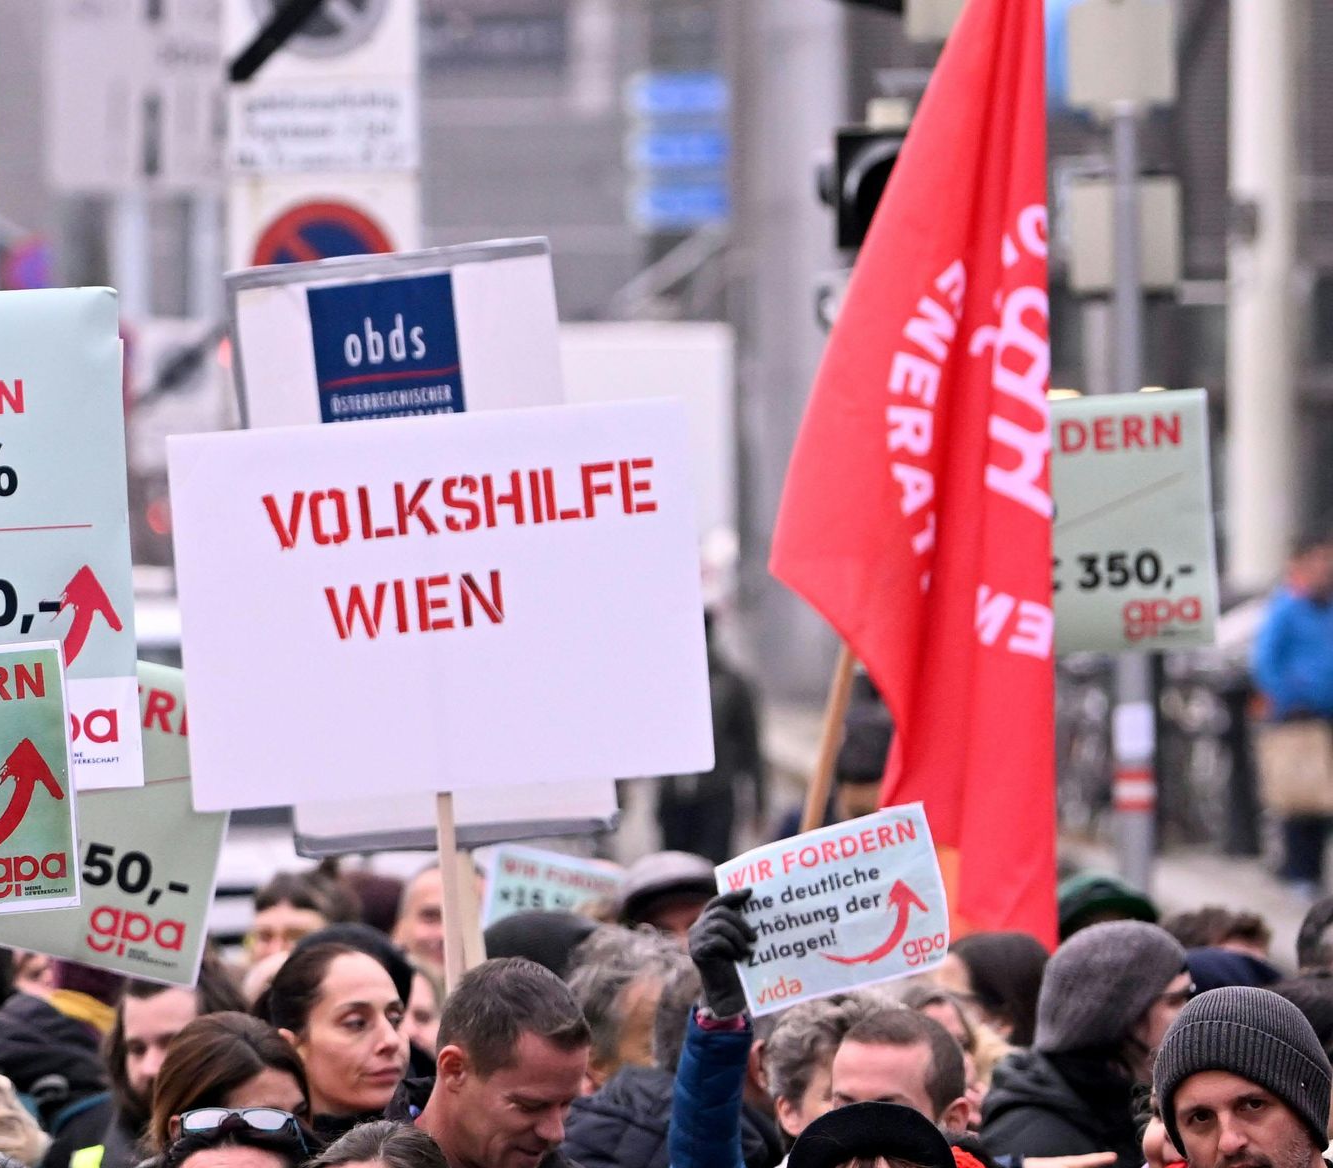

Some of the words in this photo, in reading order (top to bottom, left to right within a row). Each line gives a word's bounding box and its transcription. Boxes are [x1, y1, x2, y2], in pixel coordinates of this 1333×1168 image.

[344, 313, 426, 367] obds
[330, 385, 453, 415] ÖSTERREICHISCHER
[1053, 414, 1181, 453] DERN
[261, 457, 658, 551] VOLKSHILFE
[1078, 550, 1194, 590] 350,-
[324, 570, 505, 639] WIEN
[1123, 597, 1201, 641] gpa
[81, 843, 190, 906] 50,-
[727, 860, 772, 891] WIR
[782, 819, 917, 874] FORDERN
[744, 894, 774, 914] ine
[781, 867, 880, 903] deutliche
[87, 905, 186, 957] gpa
[752, 905, 839, 937] rhöhung
[846, 893, 881, 914] der
[748, 928, 838, 967] Zulagen!
[903, 933, 945, 966] gpa
[757, 976, 802, 1005] vida
